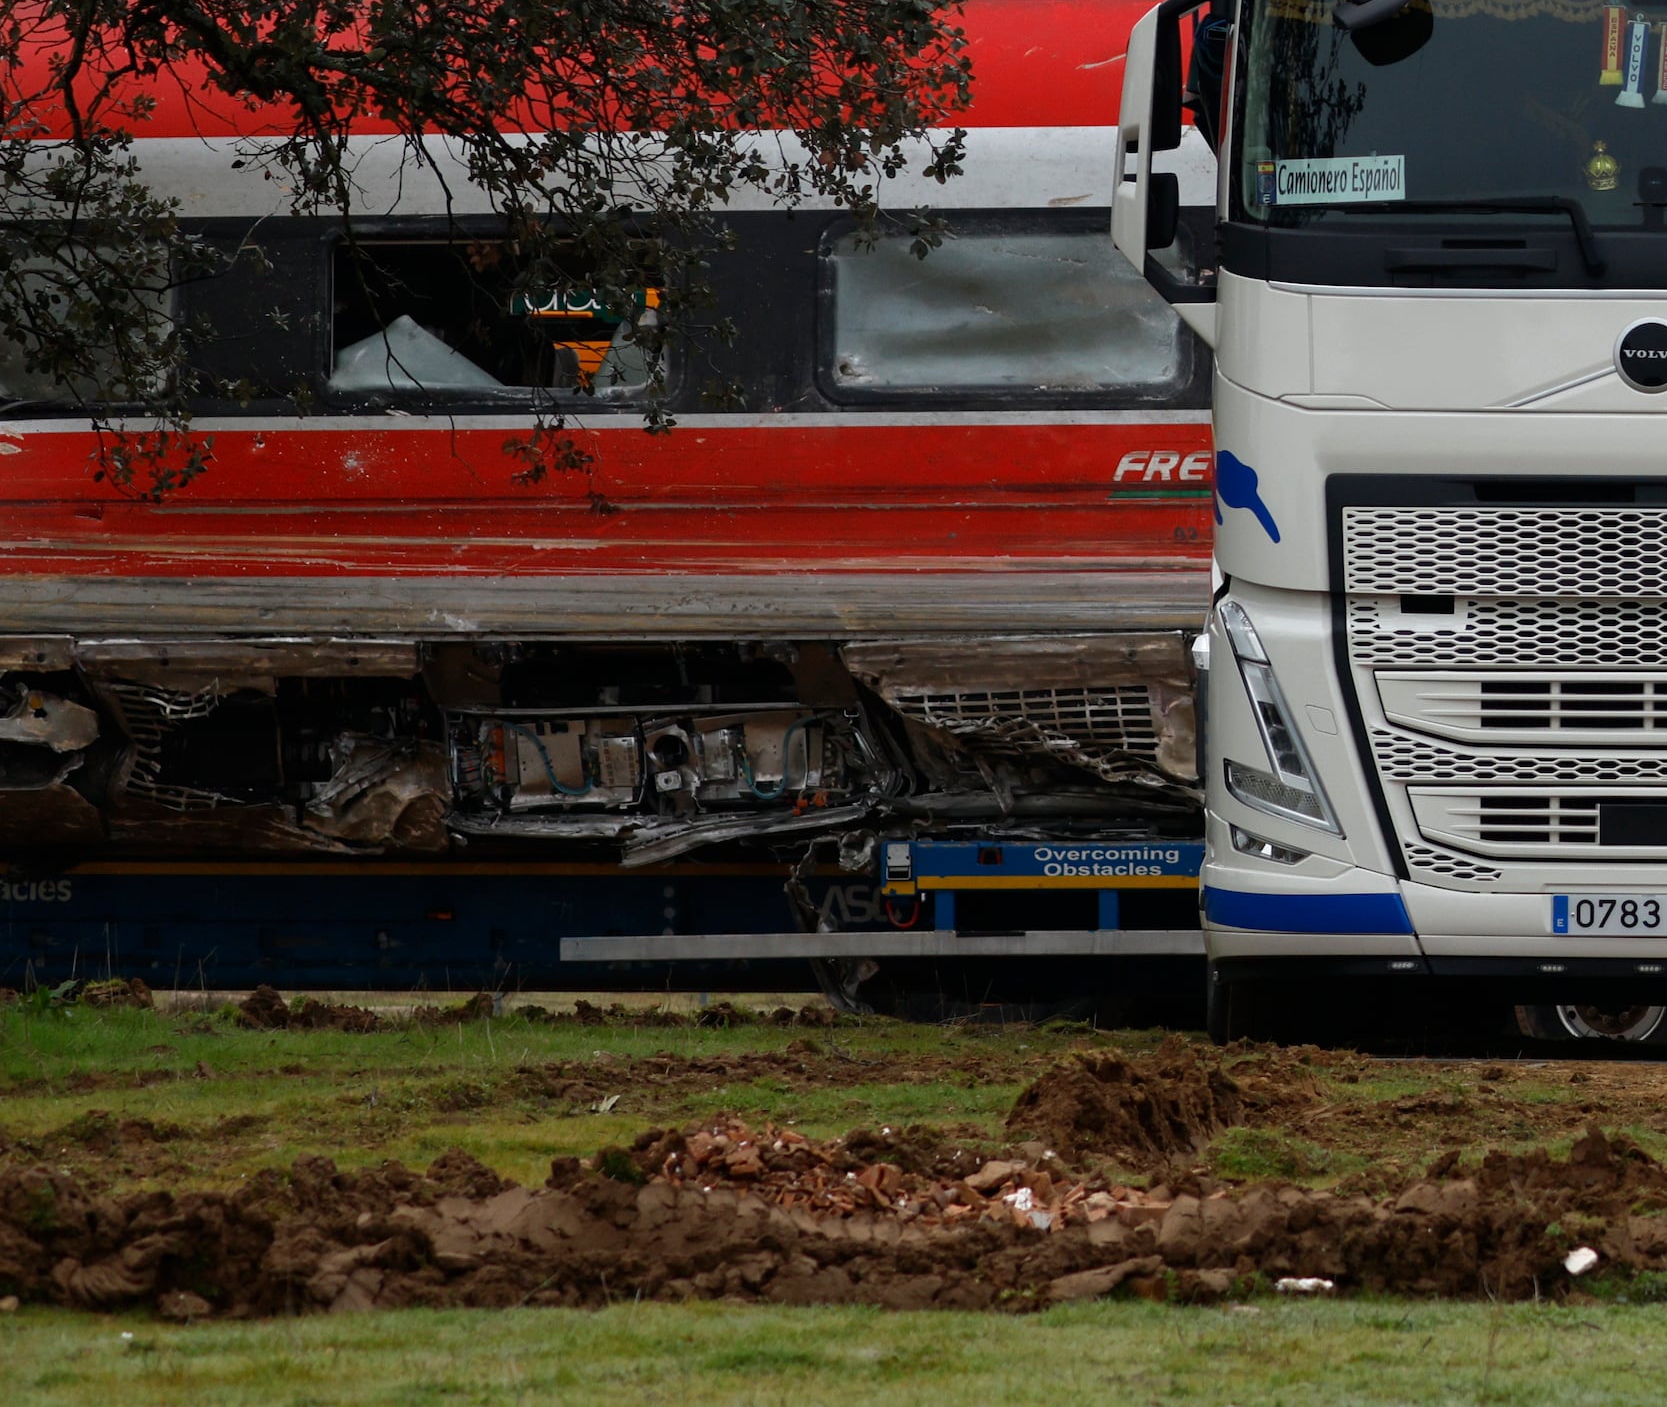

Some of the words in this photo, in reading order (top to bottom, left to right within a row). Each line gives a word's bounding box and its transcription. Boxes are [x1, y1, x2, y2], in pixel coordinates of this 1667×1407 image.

[1630, 34, 1642, 82] VOLVO
[1278, 163, 1347, 195] Camionero
[1352, 158, 1401, 199] Español
[1034, 846, 1180, 863] Overcoming
[1043, 862, 1162, 877] Obstacles
[1556, 918, 1564, 927] E
[1576, 899, 1660, 929] 0783
